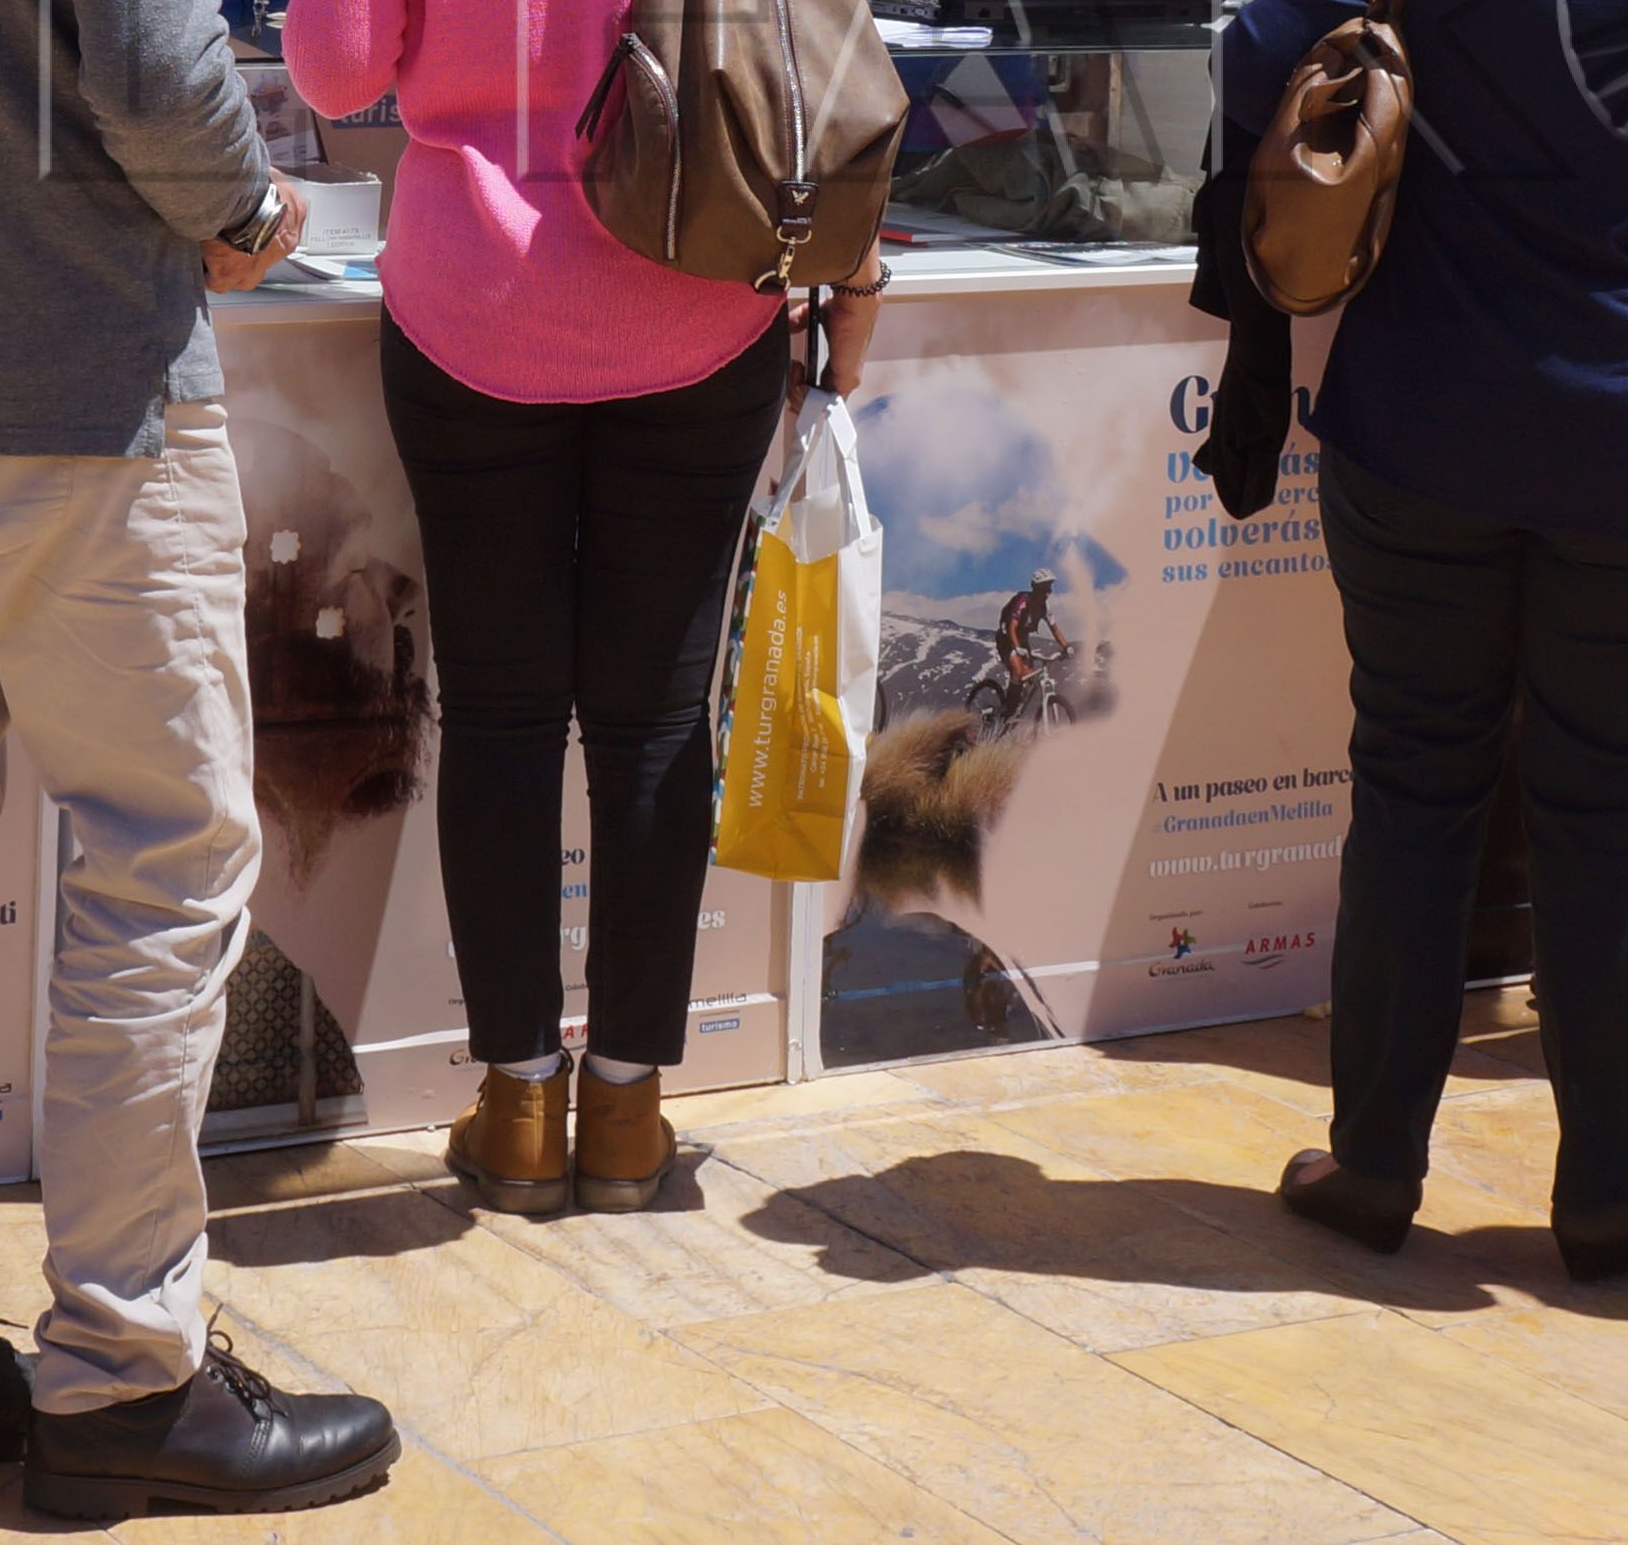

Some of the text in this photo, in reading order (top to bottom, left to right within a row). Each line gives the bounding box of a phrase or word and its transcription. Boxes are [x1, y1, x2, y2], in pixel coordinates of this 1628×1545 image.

[1165, 493, 1213, 519] por
[1164, 510, 1320, 551] volverás
[1162, 563, 1208, 583] sus
[748, 590, 787, 807] www.turgranada.es
[1155, 782, 1168, 802] A
[1174, 785, 1200, 801] un
[1205, 777, 1267, 803] paseo
[1273, 773, 1297, 791] en
[0, 901, 17, 925] ti
[1244, 932, 1316, 955] ARMAS
[701, 1020, 738, 1031] turismo
